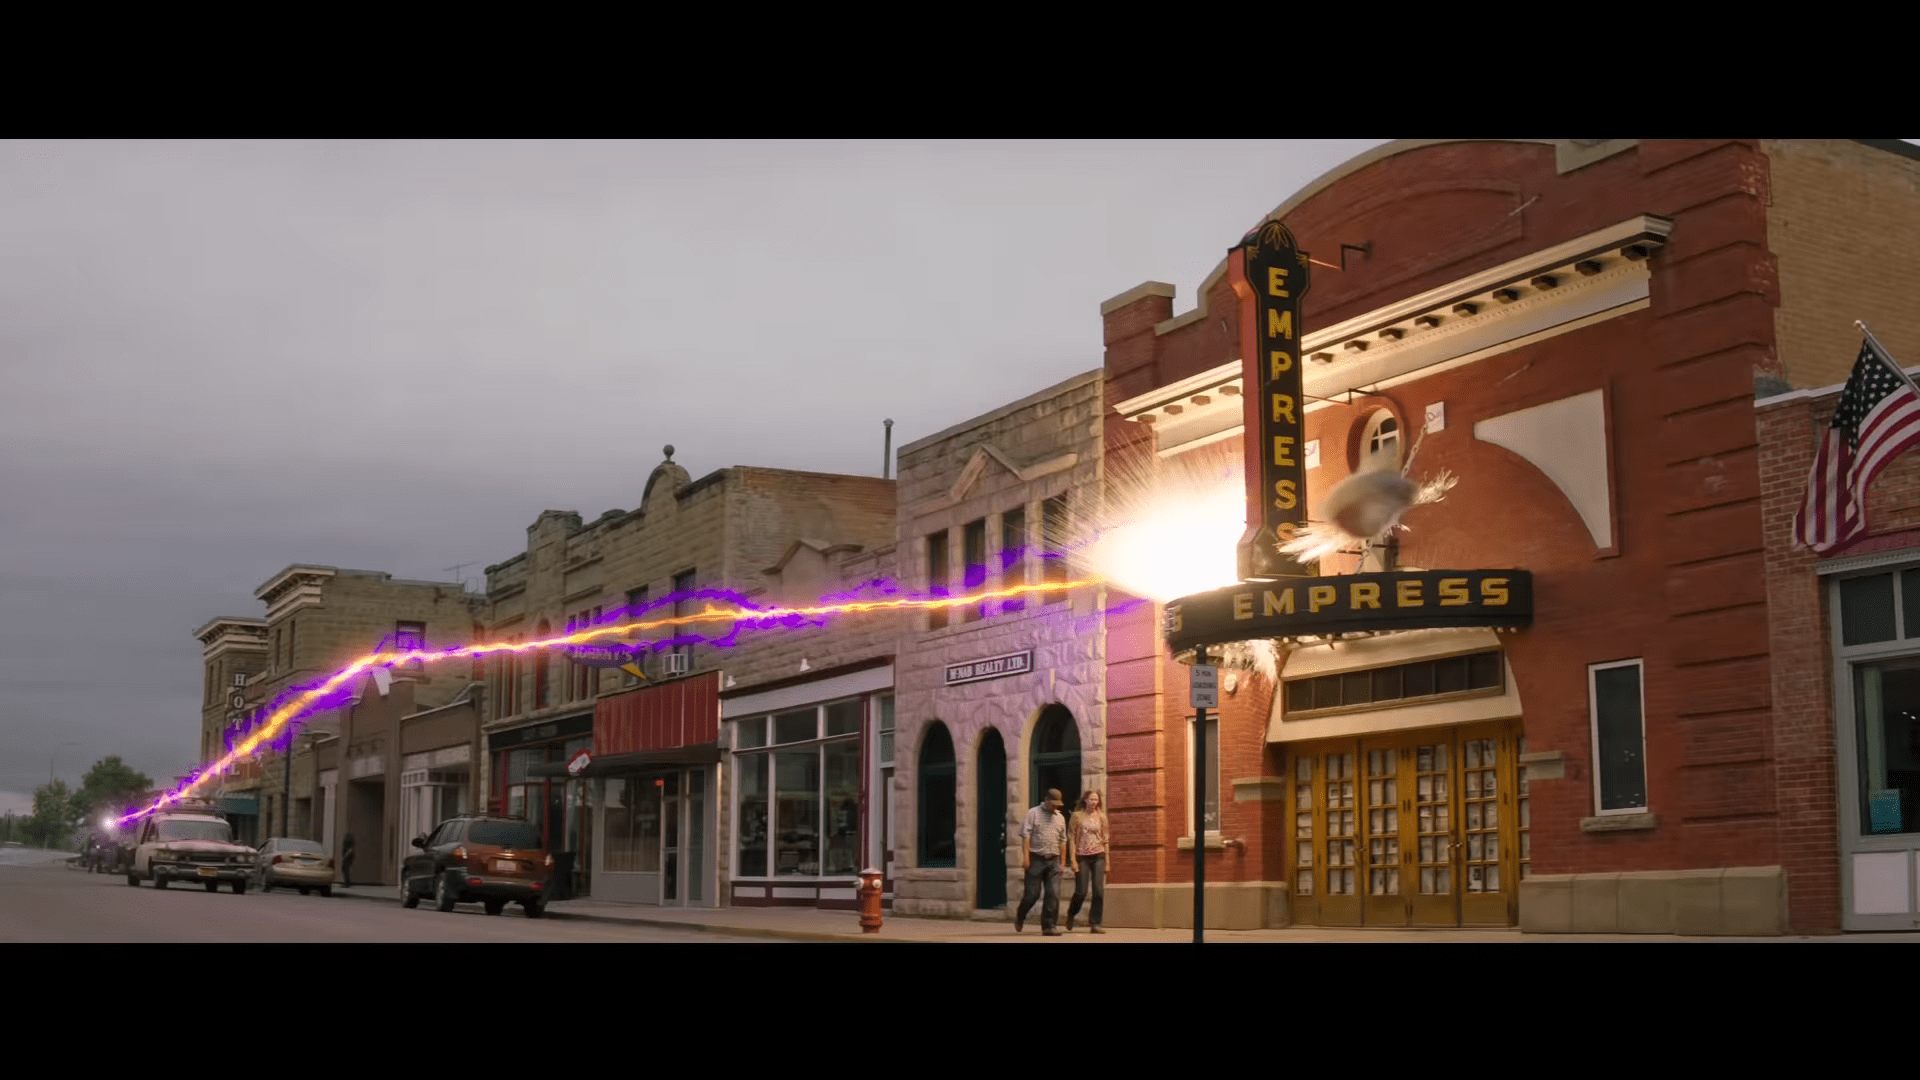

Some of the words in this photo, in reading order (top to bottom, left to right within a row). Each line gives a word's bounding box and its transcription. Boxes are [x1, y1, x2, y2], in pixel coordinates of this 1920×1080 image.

[1233, 577, 1511, 621] EMPRESS
[975, 659, 1005, 676] REALTY
[229, 673, 247, 776] HOTL
